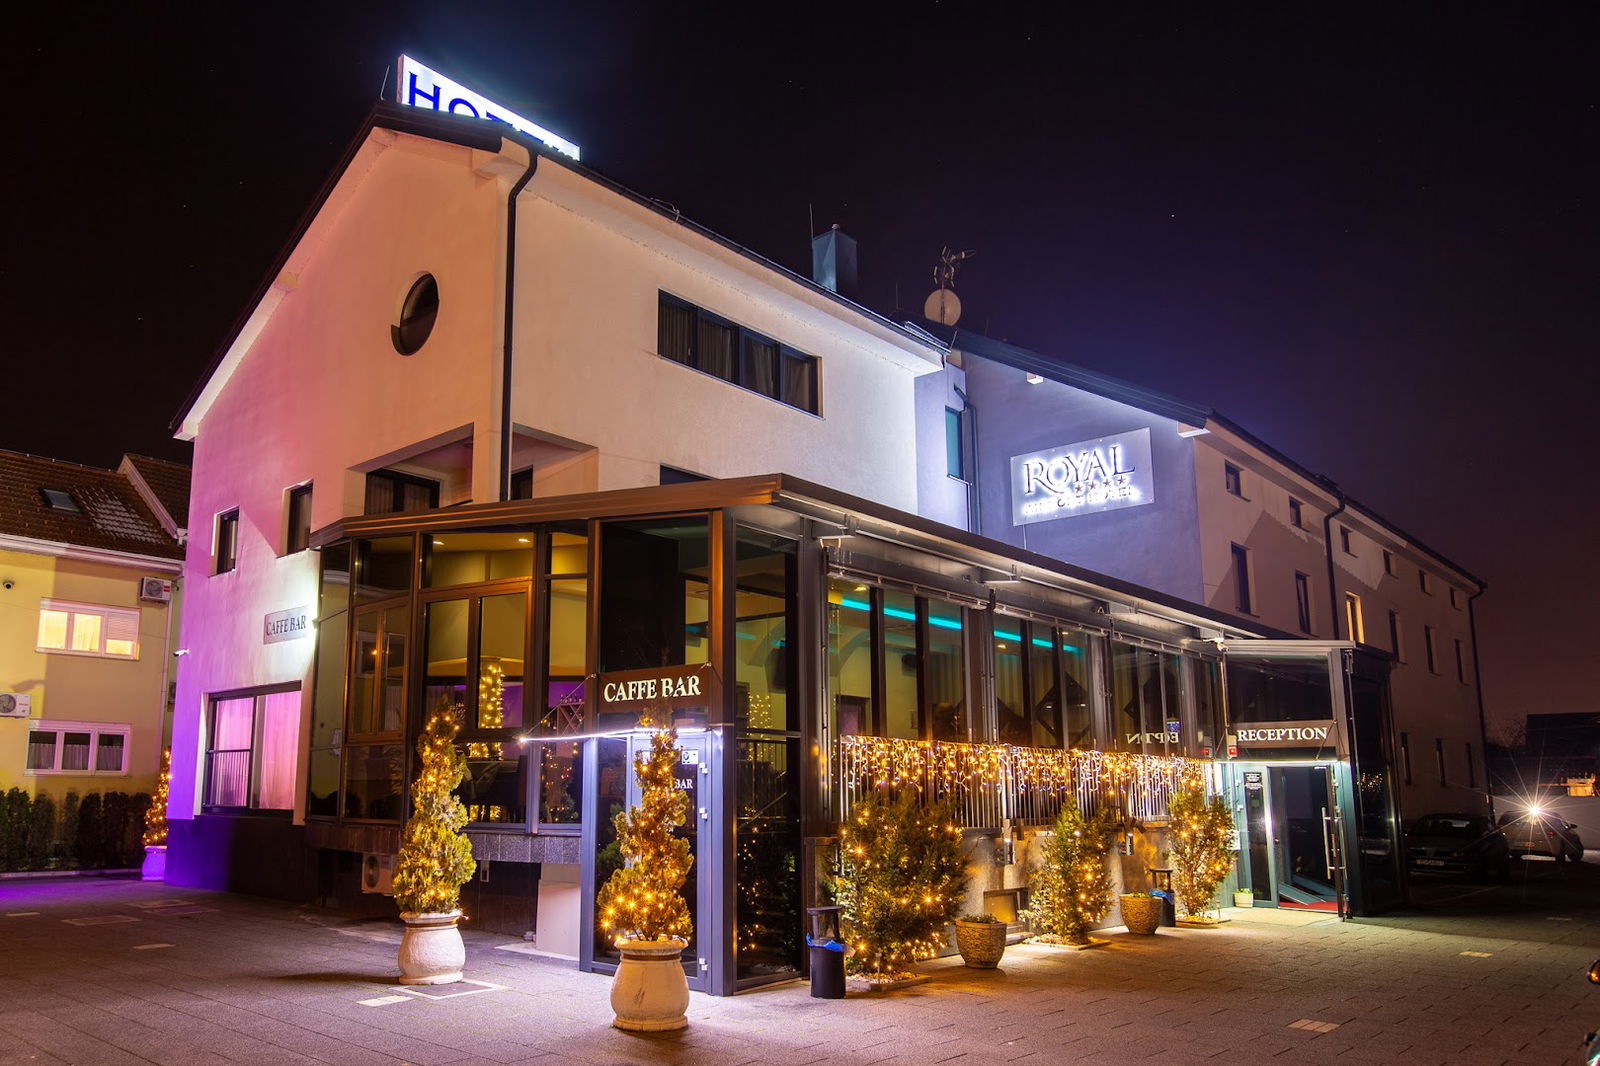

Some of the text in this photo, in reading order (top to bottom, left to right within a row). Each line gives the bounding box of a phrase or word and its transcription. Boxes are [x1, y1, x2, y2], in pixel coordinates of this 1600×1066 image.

[1023, 444, 1136, 494] ROYAL
[266, 614, 307, 636] CAFFE BAR
[603, 675, 702, 703] CAFFE BAR
[1236, 727, 1328, 742] RECEPTION
